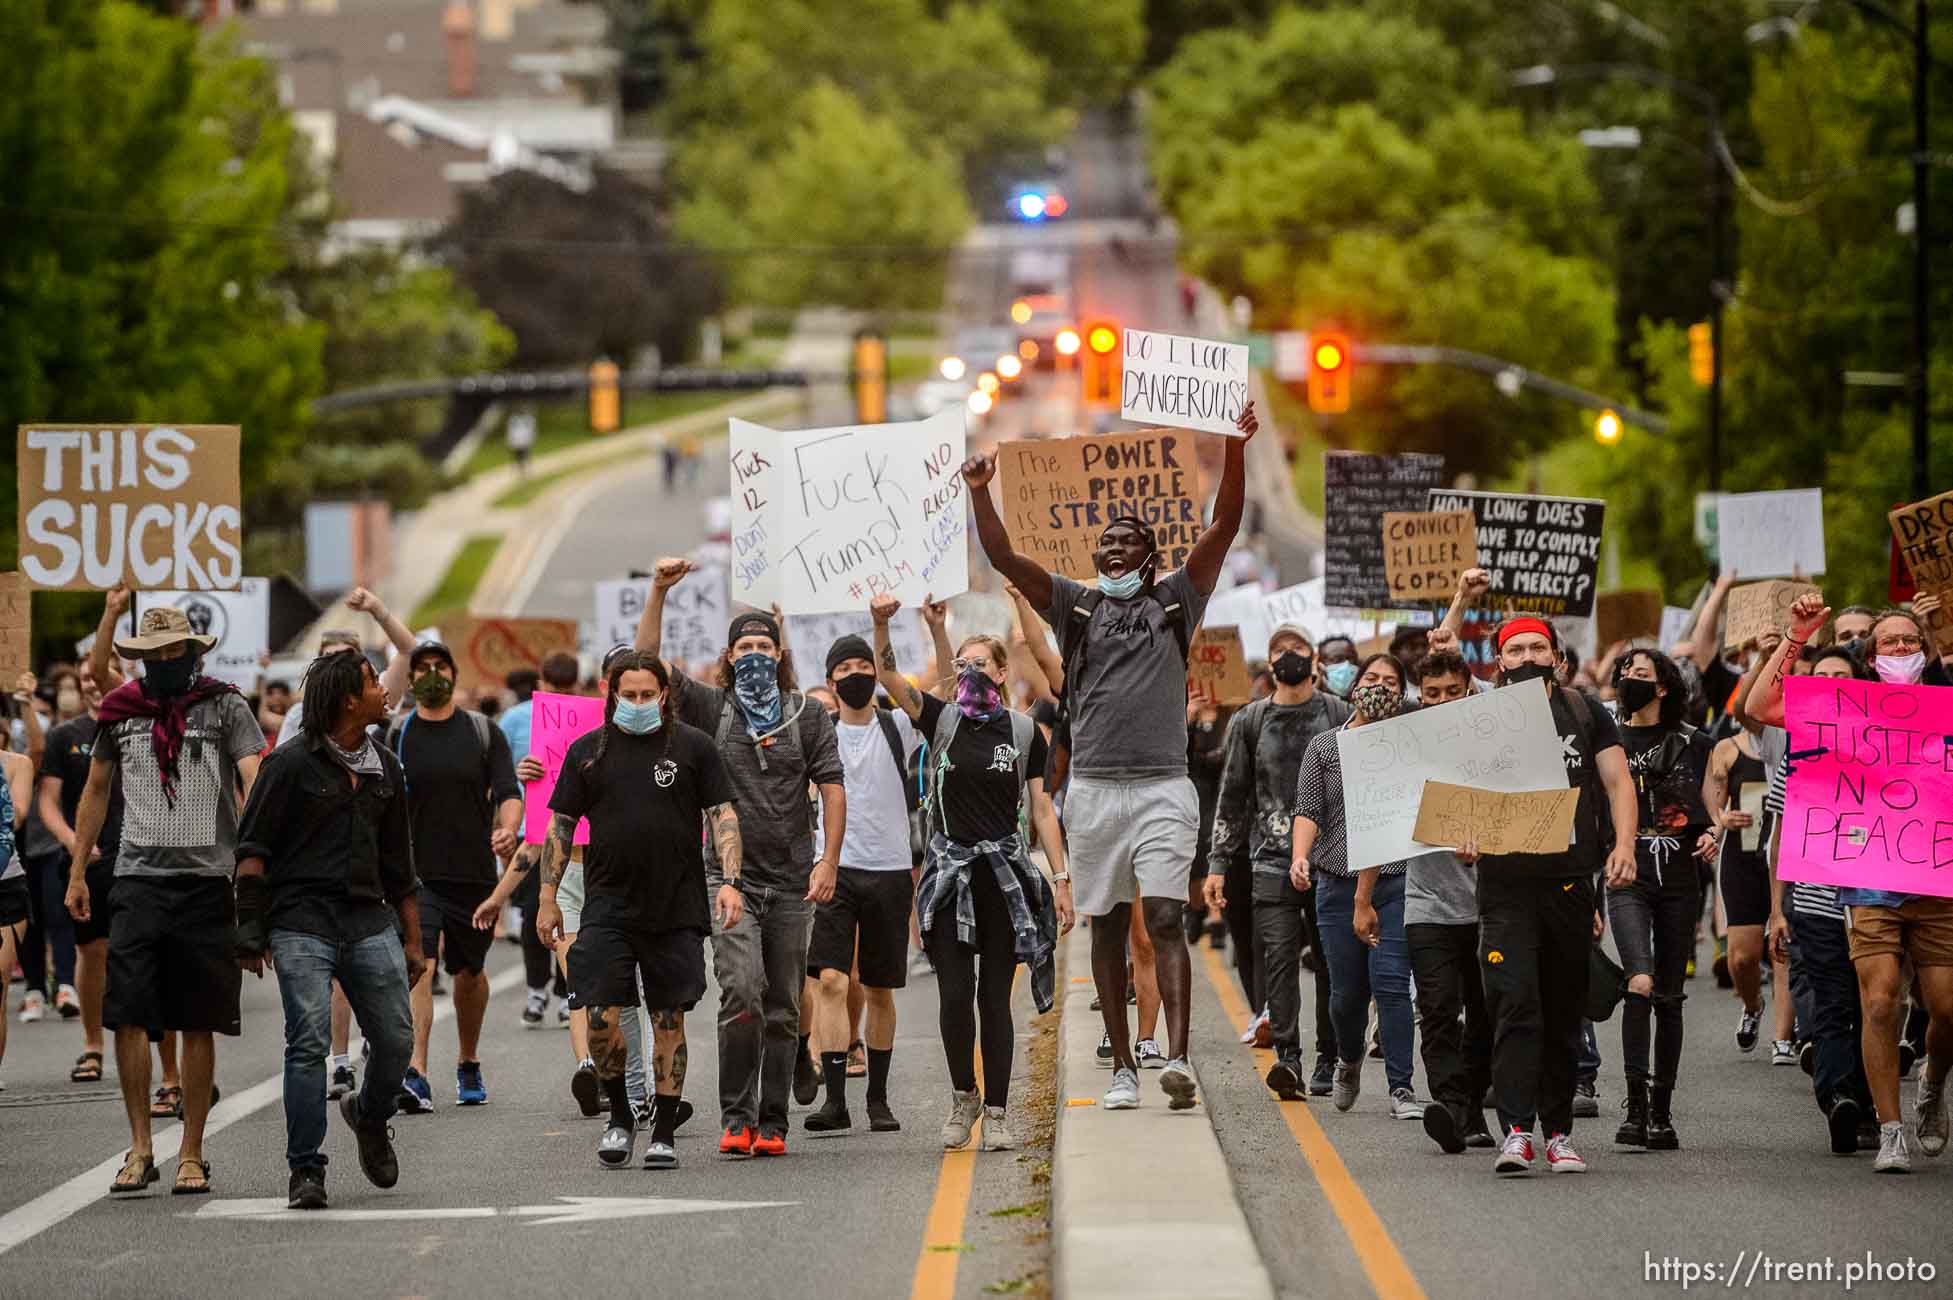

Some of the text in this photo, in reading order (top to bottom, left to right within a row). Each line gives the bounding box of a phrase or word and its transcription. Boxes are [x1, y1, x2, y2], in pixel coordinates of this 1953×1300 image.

[1126, 331, 1237, 372] DO I LOOK
[1123, 370, 1247, 423] DANGEROUS?
[26, 427, 196, 491] THIS
[924, 443, 951, 480] NO
[1018, 436, 1180, 476] The POWER
[793, 432, 910, 517] Fuck
[1048, 481, 1080, 502] the
[1088, 471, 1187, 501] PEOPLE
[743, 488, 768, 511] 12
[1050, 498, 1195, 530] STRONGER
[1483, 498, 1528, 522] LONG
[1536, 502, 1586, 528] DOES
[1389, 512, 1465, 540] CONVICT
[1476, 526, 1507, 548] AVE
[1515, 528, 1536, 549] TO
[21, 499, 241, 590] SUCKS
[779, 505, 904, 593] Trump!
[1016, 534, 1071, 554] Than
[1393, 543, 1462, 568] KILLER
[1904, 536, 1946, 565] THE
[849, 559, 915, 600] #BLM
[1544, 554, 1581, 575] AND
[1393, 570, 1460, 592] COPS!
[1513, 571, 1590, 601] MERCY?
[541, 701, 578, 729] No
[1836, 687, 1919, 719] NO
[545, 740, 568, 765] N
[1835, 770, 1919, 810] NO
[1801, 806, 1953, 869] PEACE
